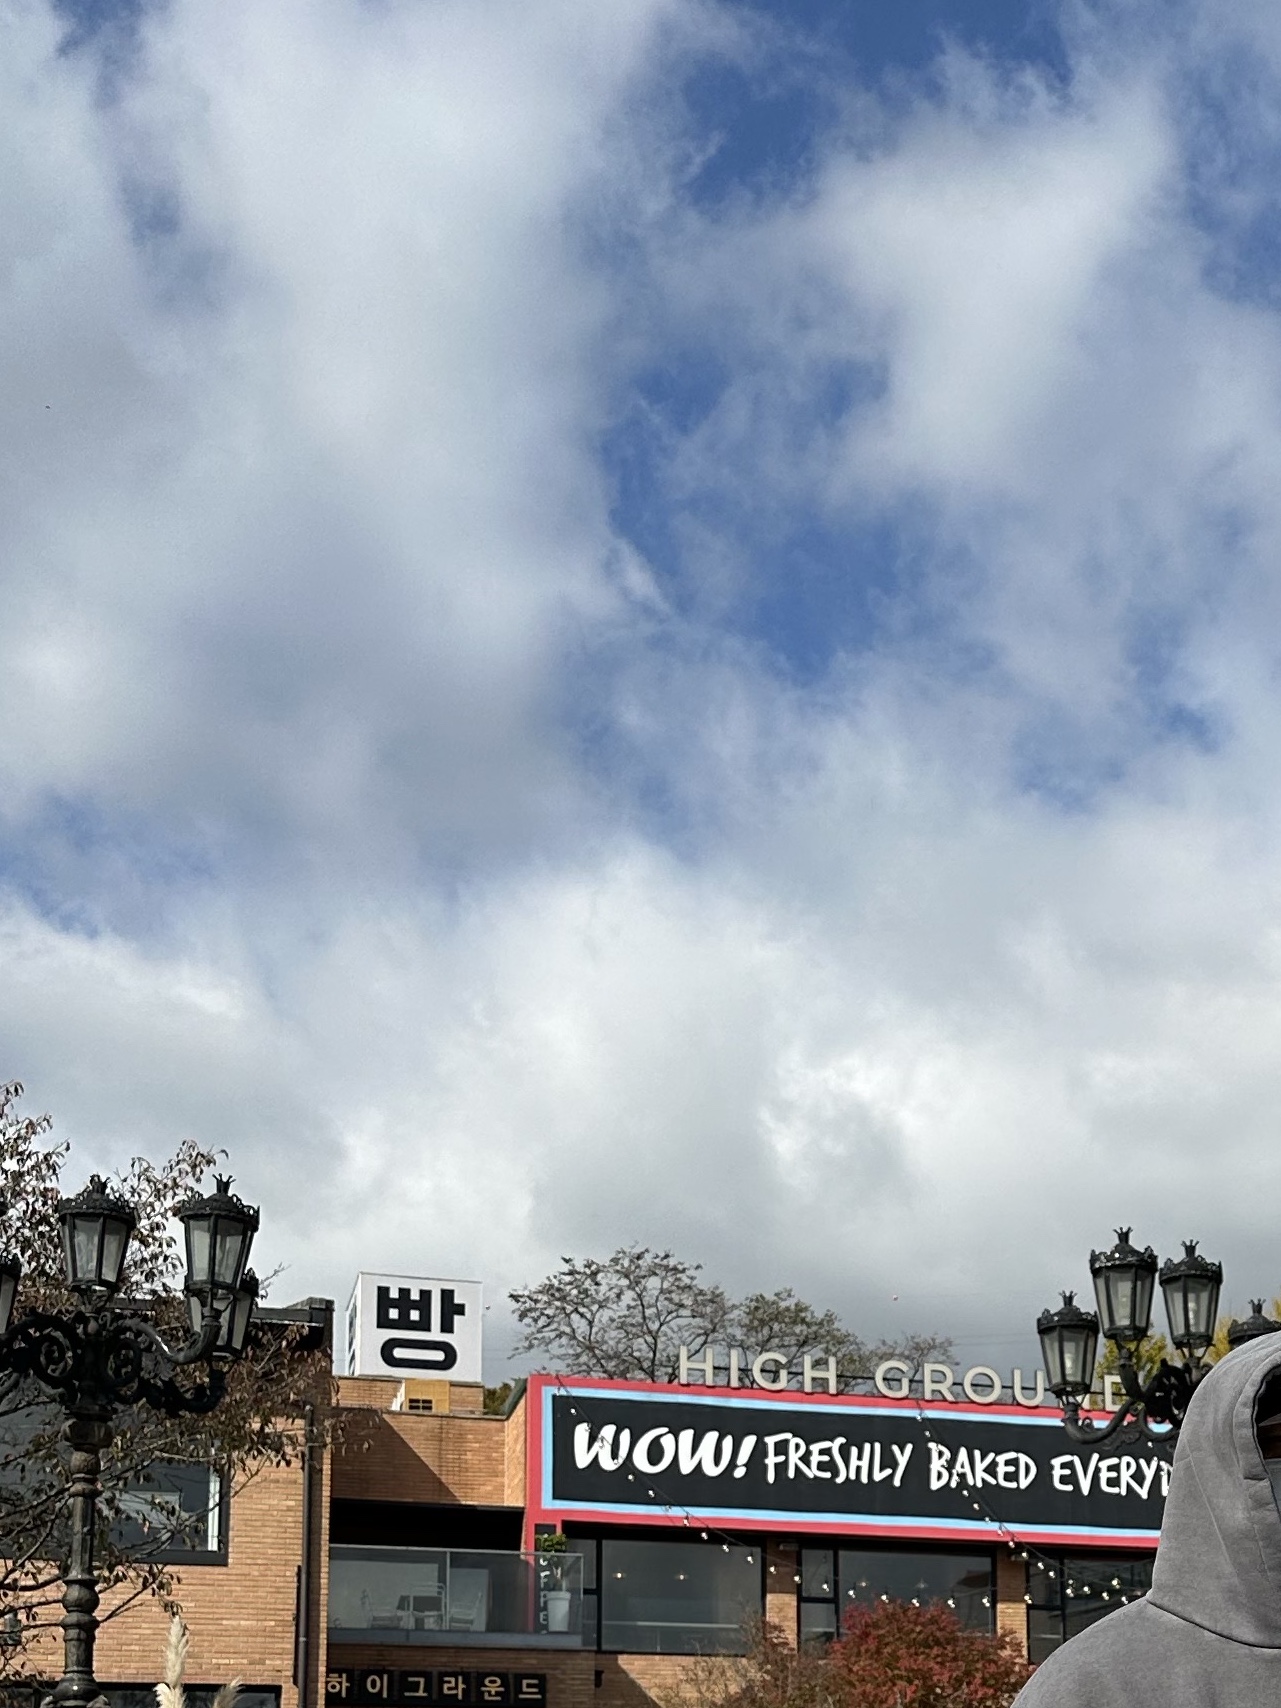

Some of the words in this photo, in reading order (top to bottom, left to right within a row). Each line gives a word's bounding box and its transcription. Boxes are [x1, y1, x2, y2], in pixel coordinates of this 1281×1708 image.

[376, 1285, 465, 1371] 빵
[678, 1345, 837, 1396] HIGH
[574, 1422, 757, 1479] WOW!
[763, 1432, 913, 1488] FRESHLY
[928, 1442, 1038, 1491] BAKED
[325, 1672, 543, 1701] 하이그라운드
